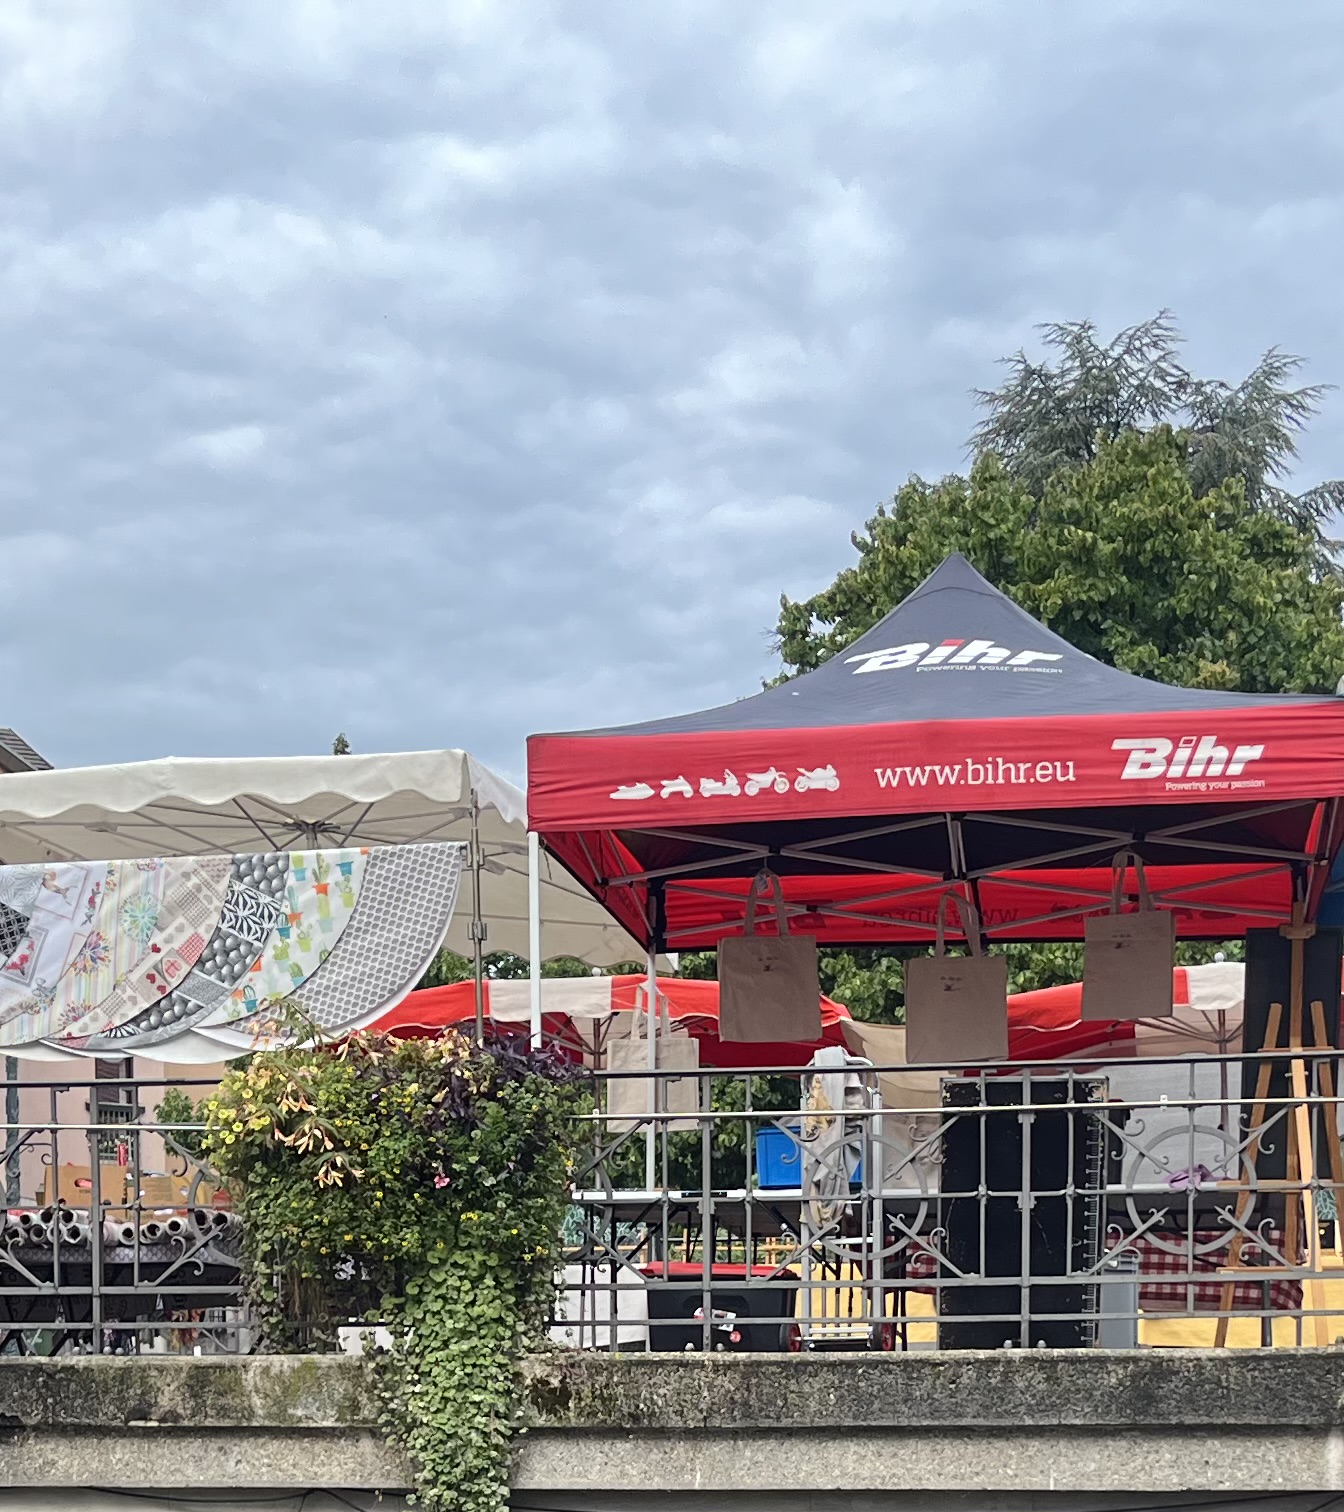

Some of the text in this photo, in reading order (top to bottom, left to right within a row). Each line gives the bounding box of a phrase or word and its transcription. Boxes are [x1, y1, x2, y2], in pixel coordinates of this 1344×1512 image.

[843, 638, 1064, 675] Bihr
[916, 664, 977, 673] Powering
[874, 757, 1076, 788] www.bihr.eu
[1111, 735, 1266, 780] Bihr
[1165, 778, 1266, 792] Powering your passion
